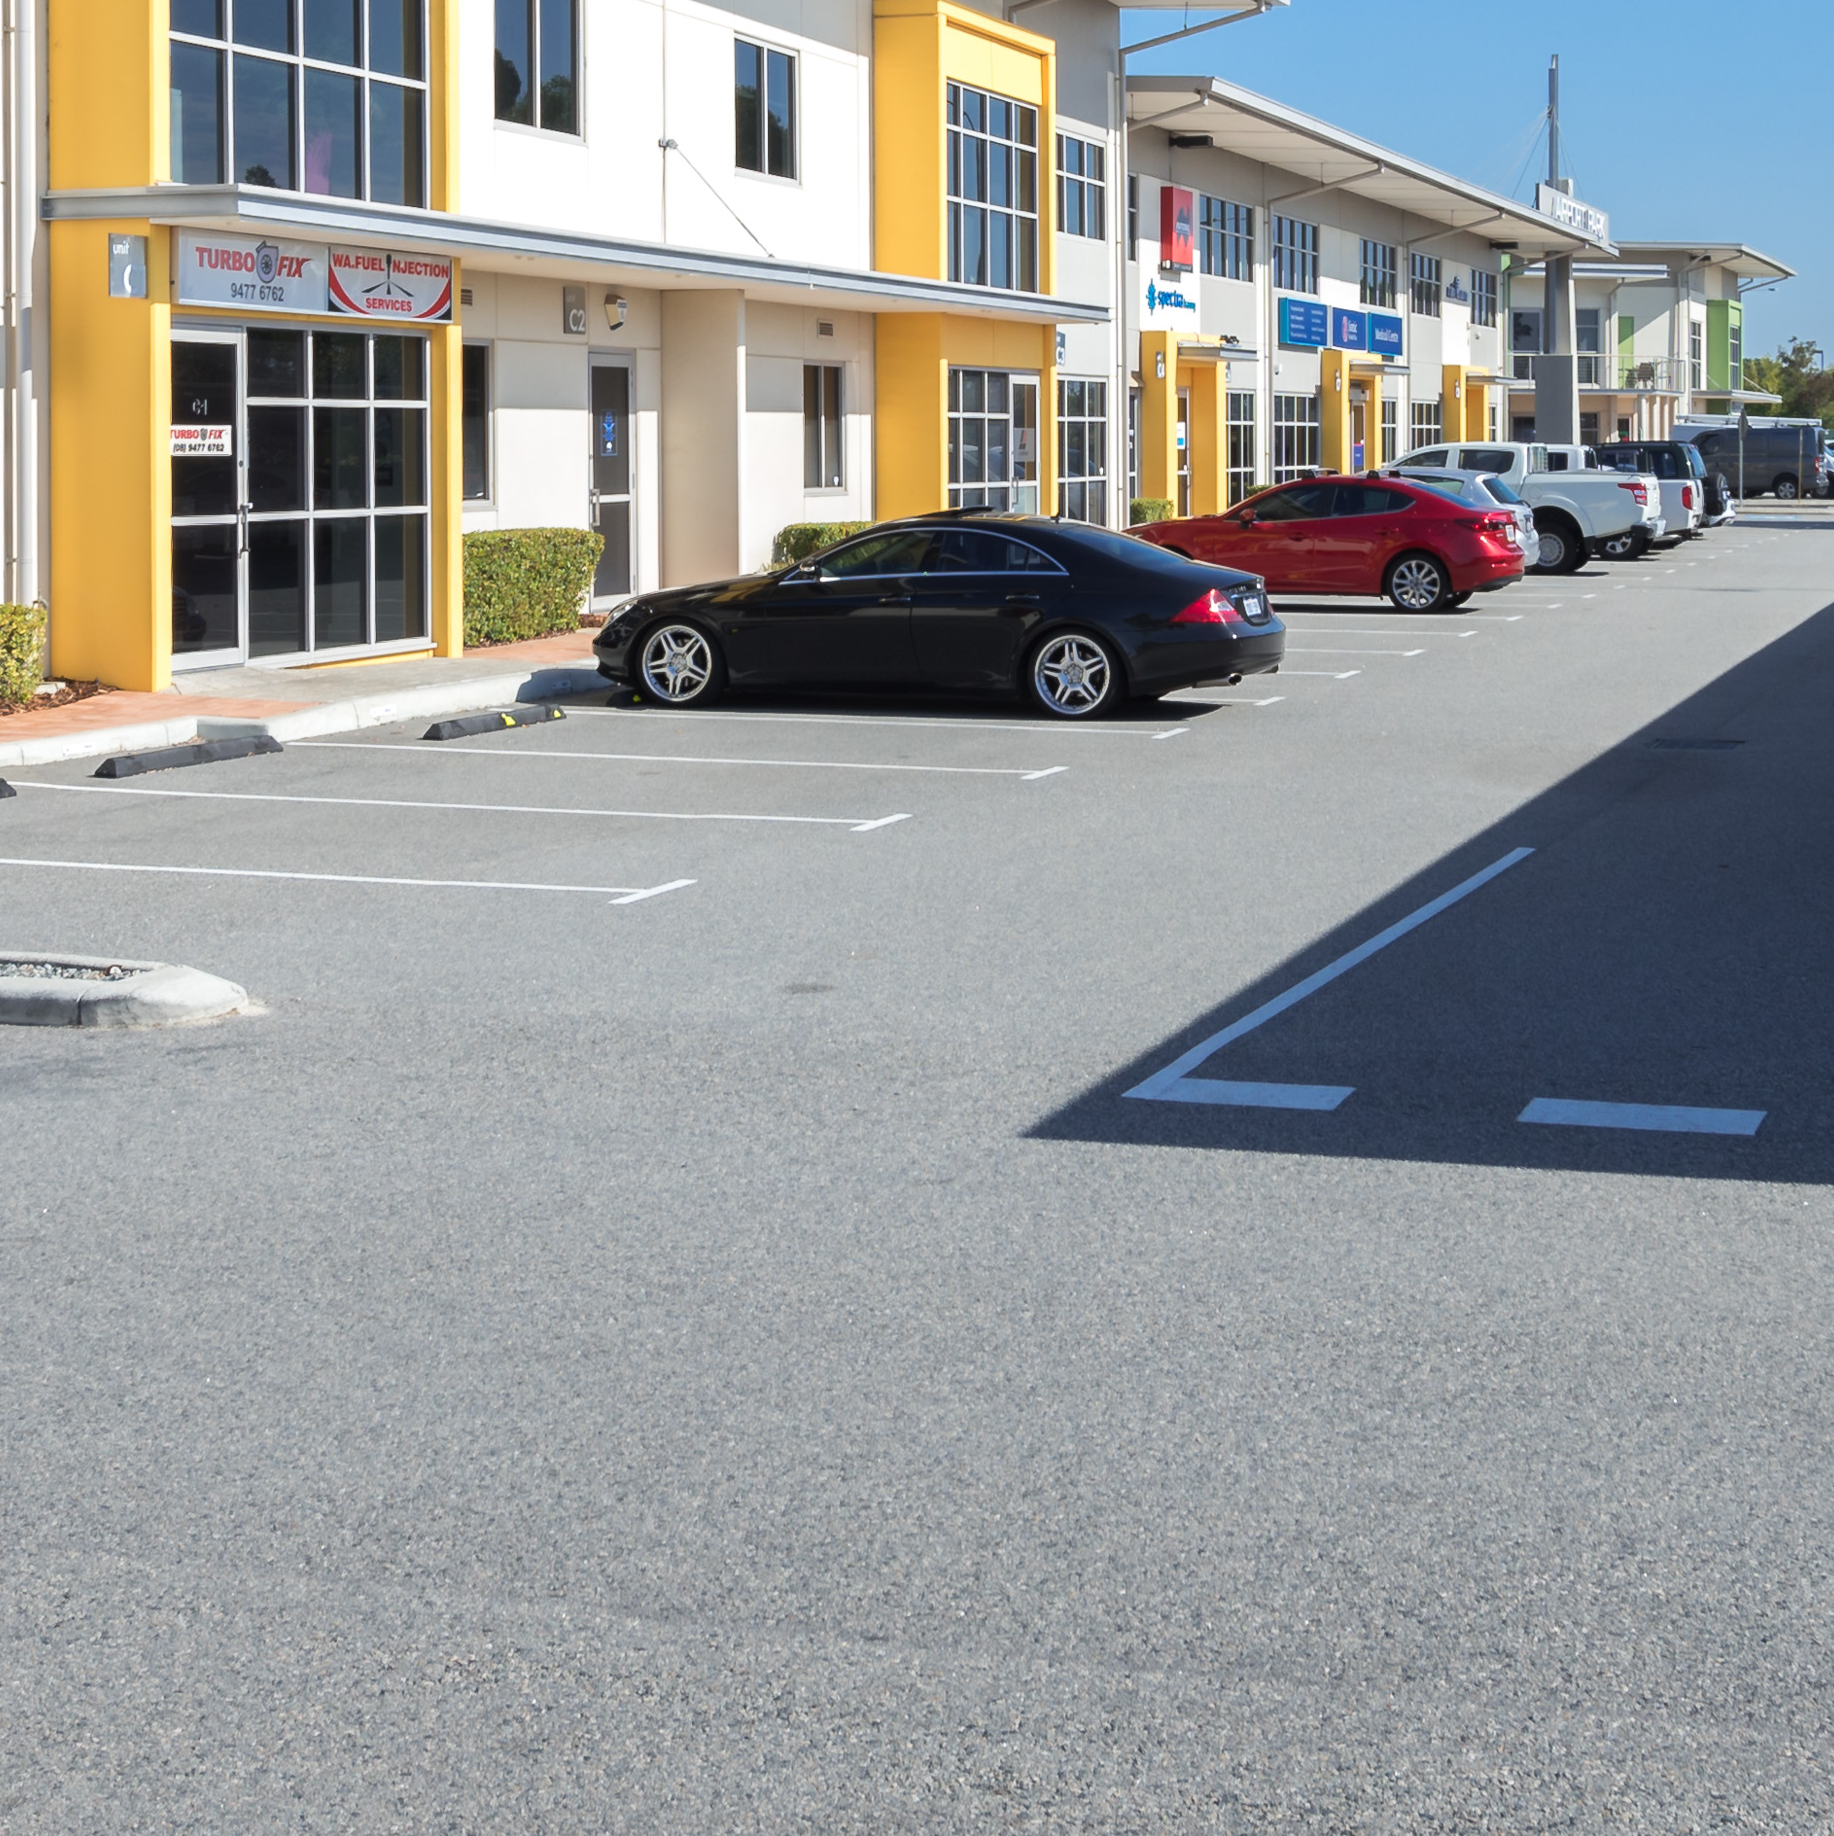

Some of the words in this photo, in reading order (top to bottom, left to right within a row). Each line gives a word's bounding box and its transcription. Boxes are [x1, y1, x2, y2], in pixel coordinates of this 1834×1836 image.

[113, 240, 129, 255] unit
[195, 246, 255, 273] TURBO
[276, 255, 313, 278] FIX
[230, 282, 256, 299] 9477
[259, 285, 284, 302] 6762
[365, 297, 413, 312] SERVICES
[569, 308, 585, 332] C2
[208, 429, 226, 439] FIX
[188, 443, 205, 452] 9477
